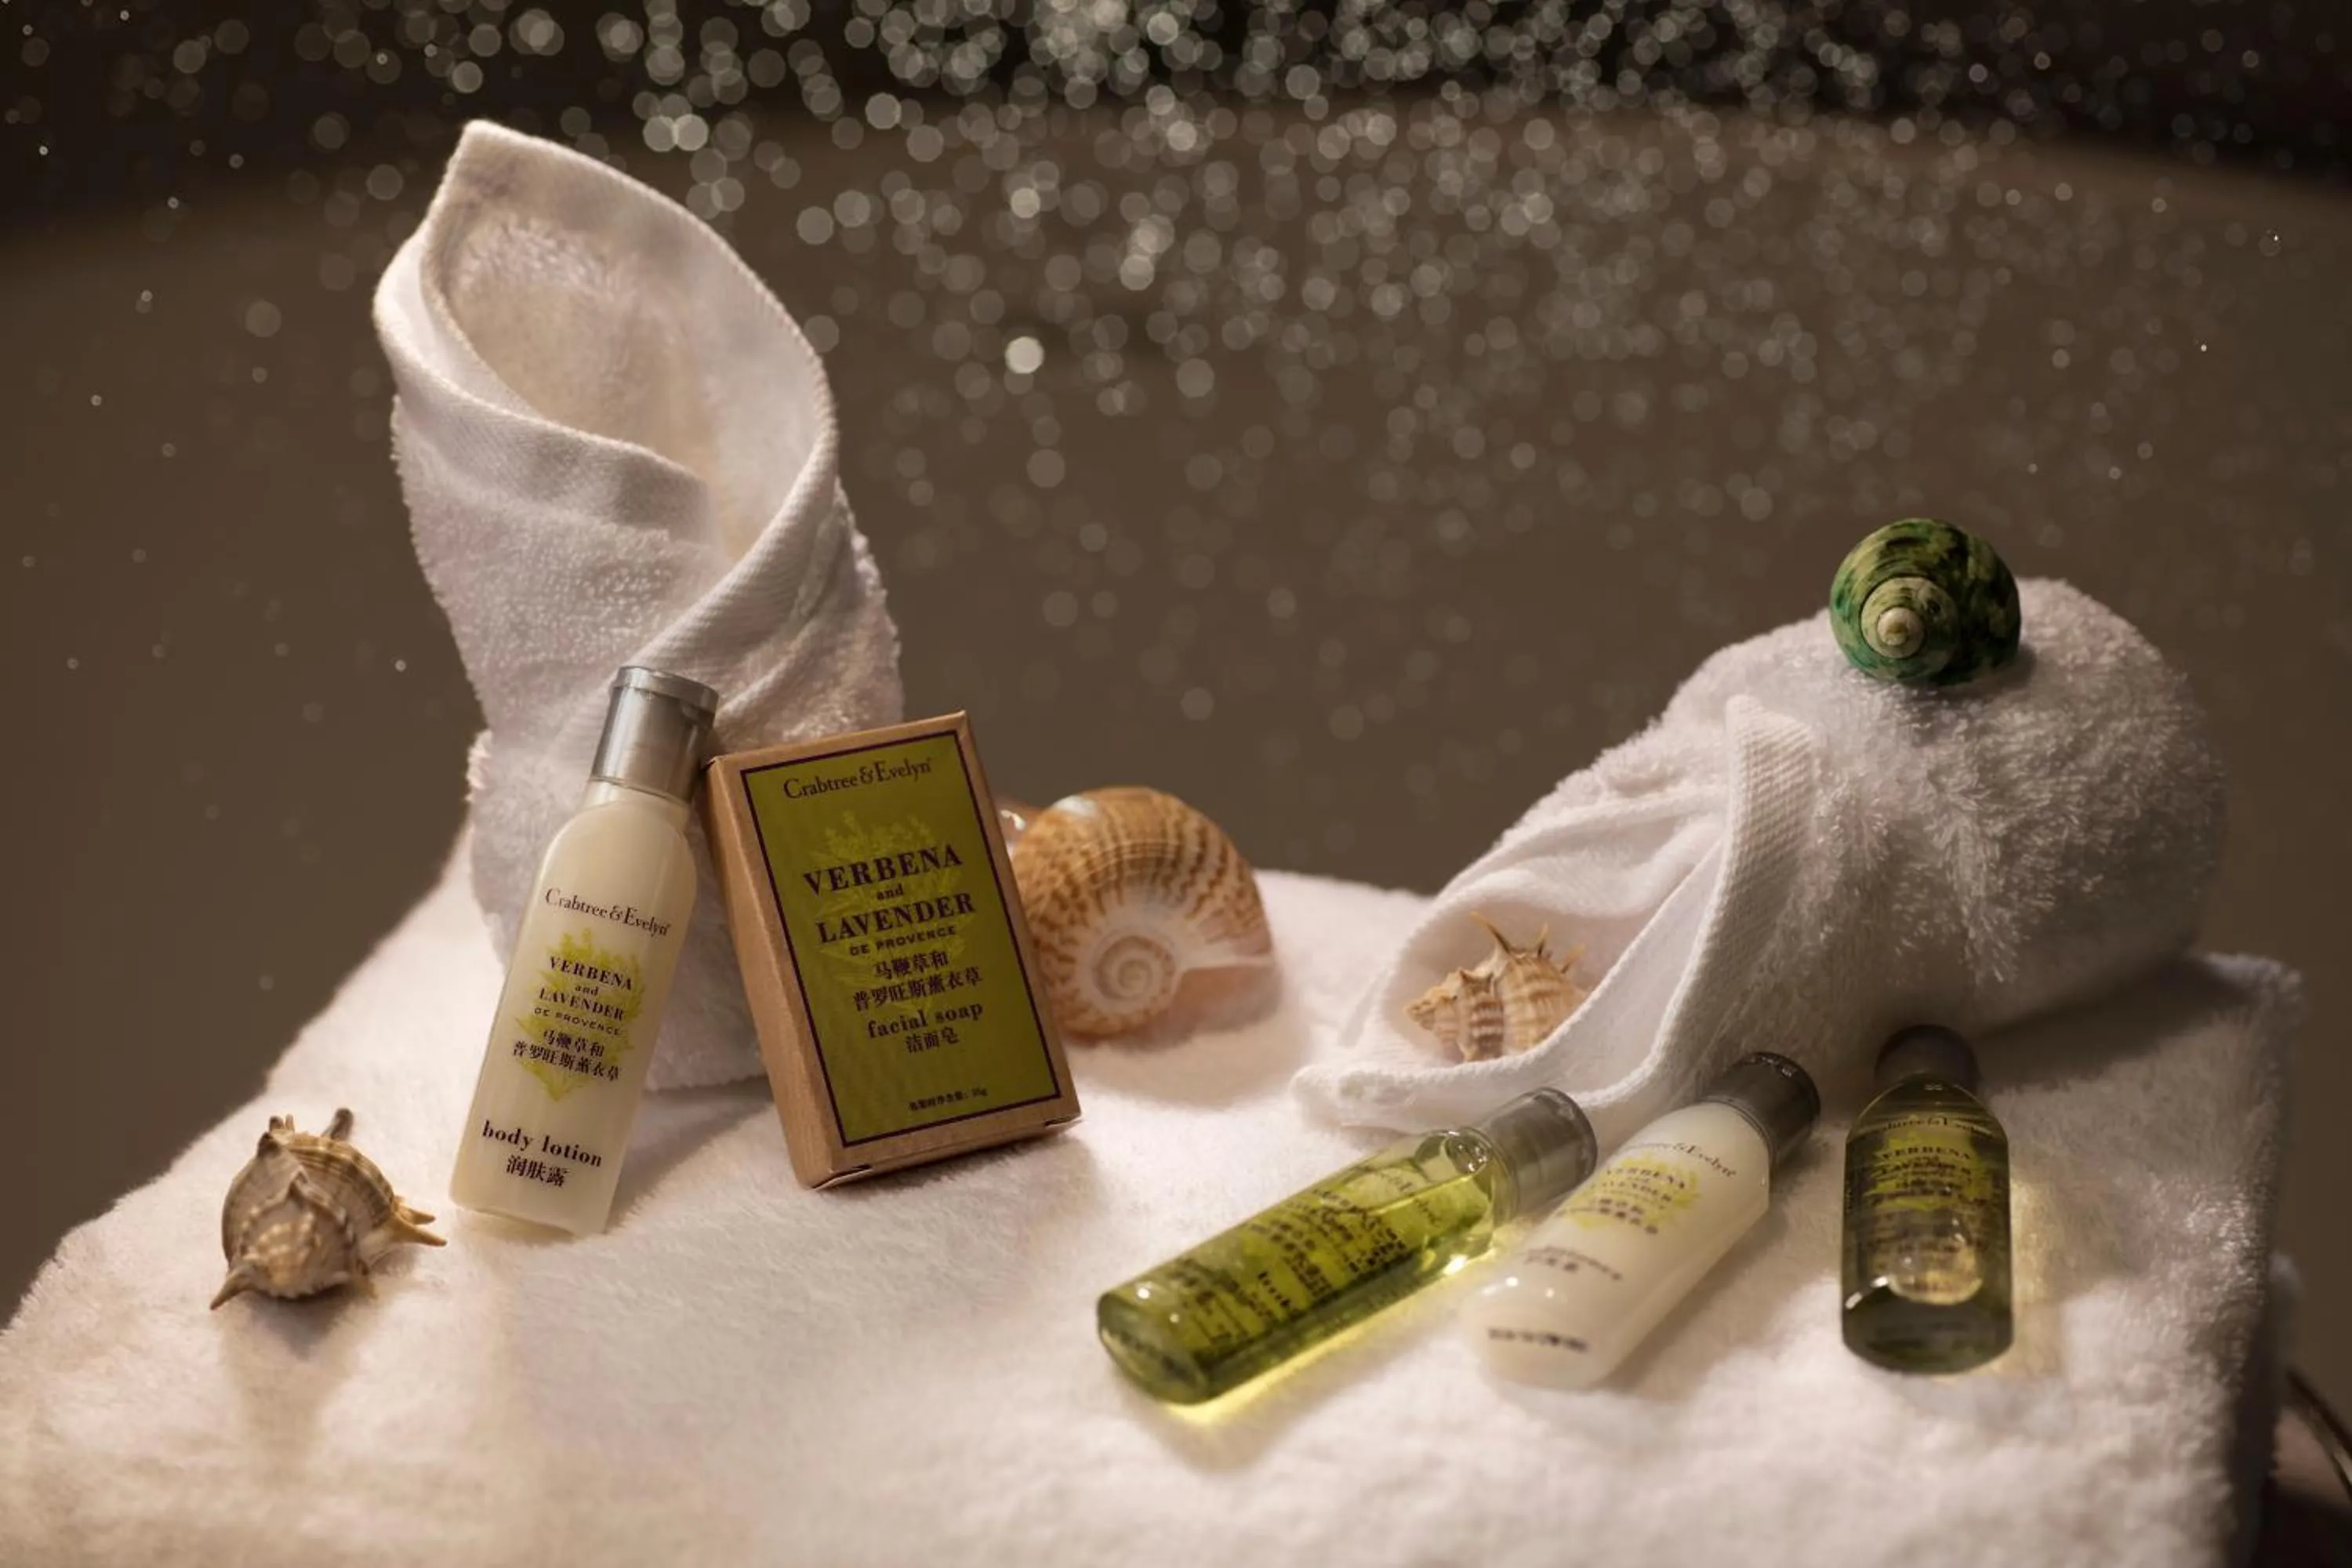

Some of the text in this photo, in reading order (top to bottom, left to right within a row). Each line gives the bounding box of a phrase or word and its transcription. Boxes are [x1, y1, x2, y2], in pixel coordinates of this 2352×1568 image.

[803, 844, 963, 896] VERBENA
[877, 884, 904, 900] and
[816, 892, 975, 943] LAVENDER
[876, 926, 956, 951] PROVENCE
[550, 956, 632, 991] VERBENA
[539, 987, 625, 1021] LAVENDER
[575, 985, 599, 996] and
[555, 1011, 621, 1036] PROVENCE
[868, 1004, 983, 1038] facial soap
[906, 1026, 960, 1053] 洁面皂
[482, 1120, 602, 1167] body lotion
[506, 1154, 570, 1187] 润肤露
